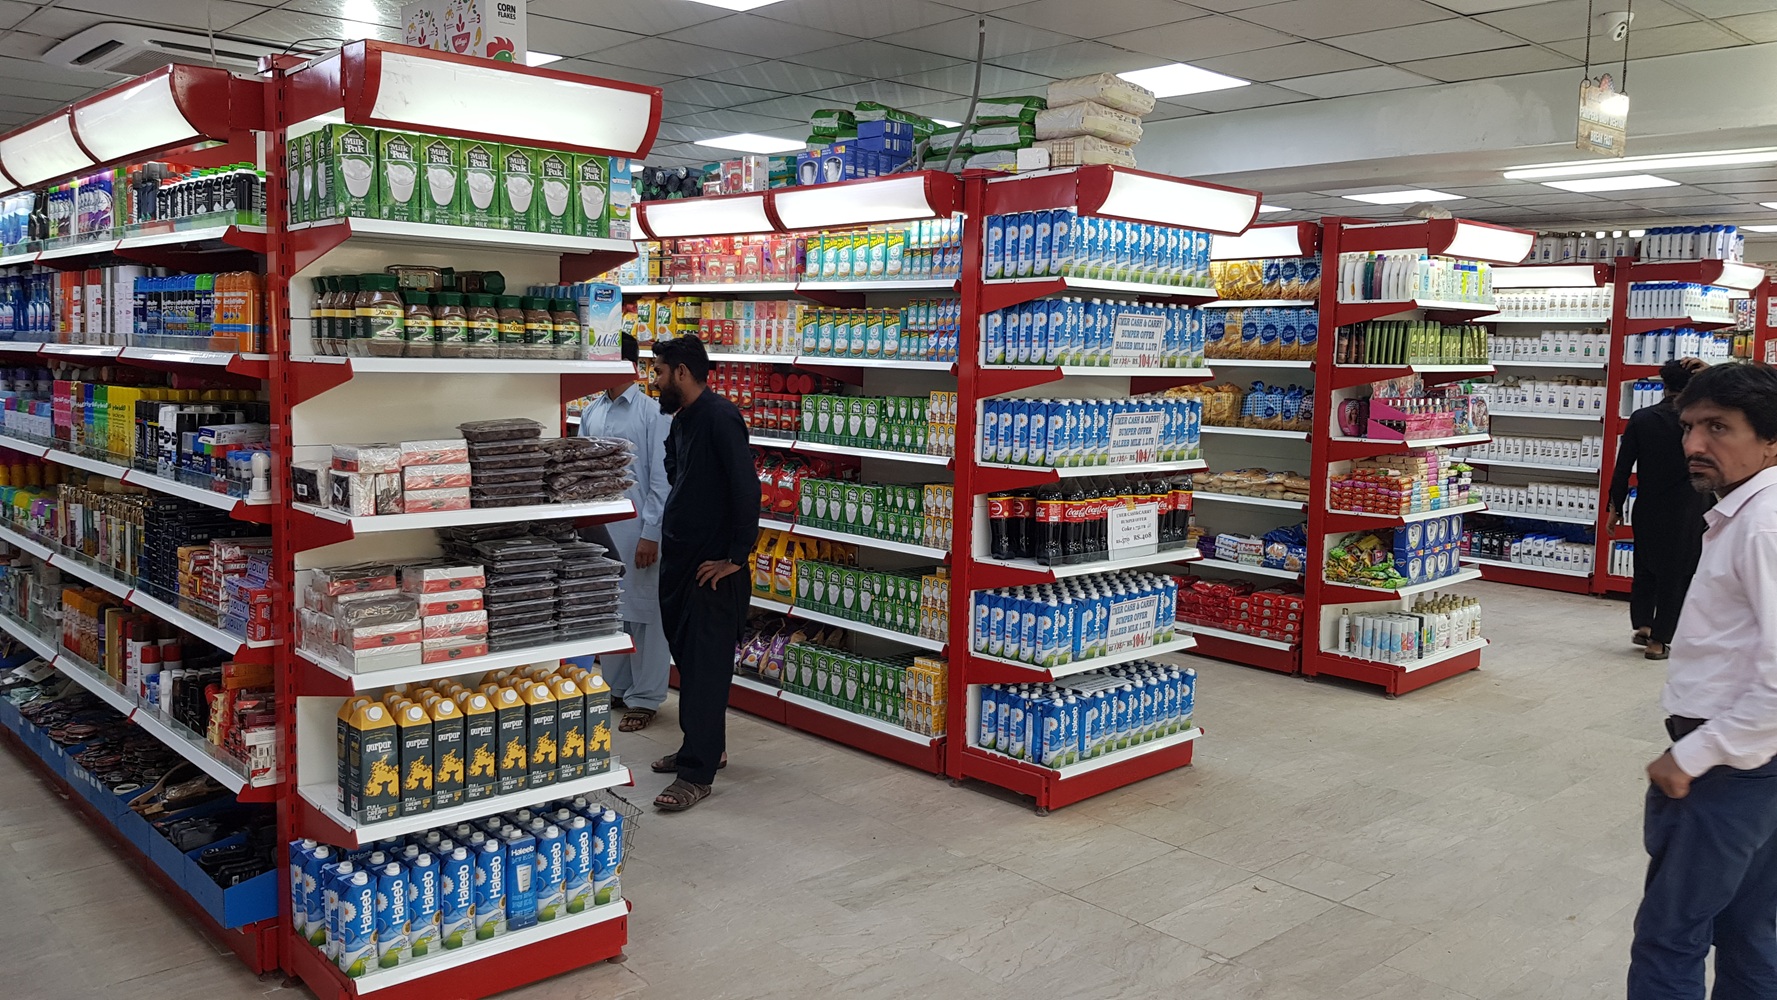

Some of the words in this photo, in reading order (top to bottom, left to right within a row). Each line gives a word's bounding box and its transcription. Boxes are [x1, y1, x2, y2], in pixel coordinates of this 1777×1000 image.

[497, 3, 516, 13] CORN
[498, 11, 516, 20] FLAKES
[345, 137, 364, 146] Milk
[345, 145, 365, 154] Pak
[389, 144, 409, 152] Milk
[430, 149, 449, 157] Milk
[390, 151, 410, 160] Pak
[430, 155, 449, 164] Pak
[470, 152, 488, 160] Milk
[470, 160, 488, 168] Pak
[508, 157, 526, 165] Milk
[546, 162, 563, 170] Milk
[510, 164, 527, 172] Pak
[546, 169, 563, 177] Pak
[583, 166, 600, 174] Milk
[585, 173, 600, 181] Pak
[1069, 216, 1077, 247] Haleeb
[1152, 227, 1160, 256] Haleeb
[1065, 306, 1073, 337] Haleeb
[1095, 308, 1103, 338] Haleeb
[1131, 319, 1143, 327] CASH
[1148, 320, 1163, 328] CARRY
[1122, 330, 1140, 338] BUMPER
[1140, 331, 1155, 339] OFFER
[594, 333, 619, 347] Milk
[1115, 342, 1133, 350] HALEEB
[1133, 342, 1144, 350] MILK
[1064, 409, 1072, 440] Haleeb
[1128, 416, 1140, 424] CASH
[1145, 415, 1160, 423] CARRY
[1119, 428, 1137, 436] BUMPER
[1138, 427, 1152, 435] OFFER
[1112, 440, 1129, 448] HALEEB
[1130, 439, 1141, 447] MILK
[249, 563, 265, 574] JOLLY
[231, 600, 246, 612] JOLLY
[1124, 603, 1135, 612] CASH
[1141, 600, 1154, 609] CARRY
[1094, 603, 1102, 631] Haleeb
[1116, 615, 1133, 625] BUMPER
[1134, 611, 1148, 621] OFFER
[228, 619, 243, 631] JOLLY
[1110, 626, 1127, 637] HALEEB
[1128, 624, 1138, 633] MILK
[511, 845, 535, 857] Haleeb
[607, 826, 618, 867] Haleeb
[580, 832, 589, 874] Haleeb
[551, 842, 562, 884] Haleeb
[490, 856, 502, 899] Haleeb
[457, 864, 469, 908] Haleeb
[422, 871, 434, 915] Haleeb
[391, 880, 404, 926] Haleeb
[360, 889, 372, 935] Haleeb
